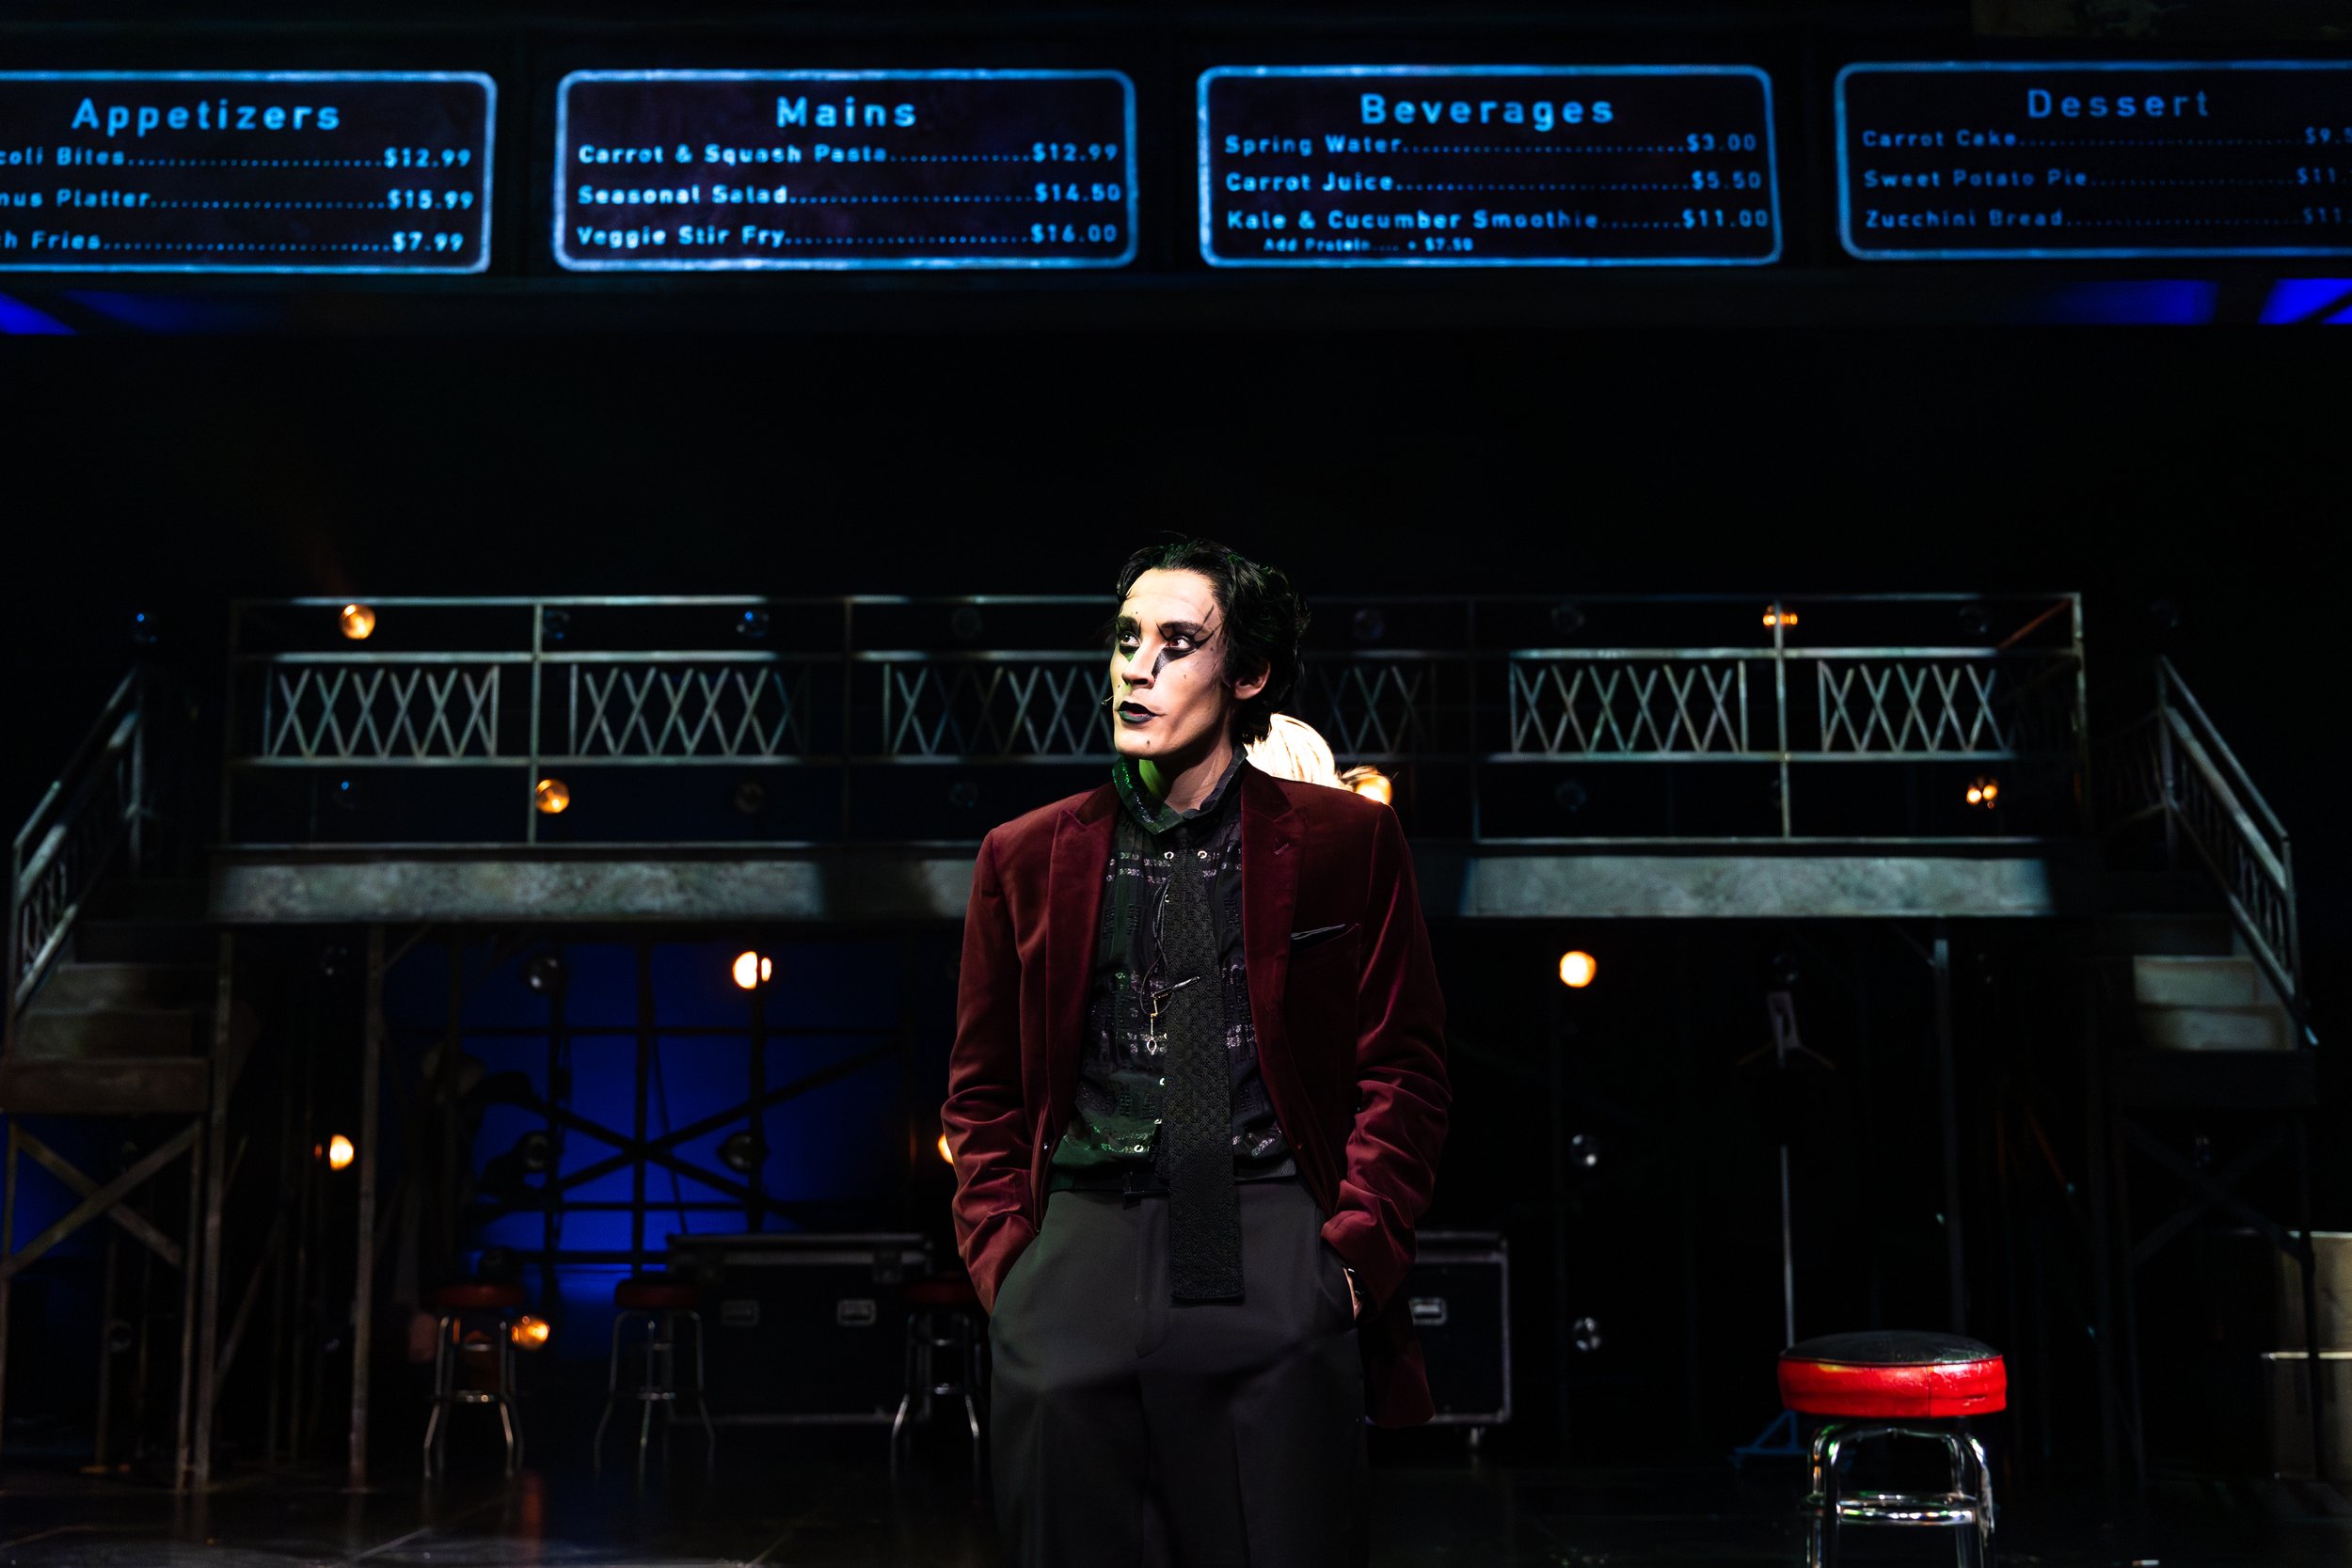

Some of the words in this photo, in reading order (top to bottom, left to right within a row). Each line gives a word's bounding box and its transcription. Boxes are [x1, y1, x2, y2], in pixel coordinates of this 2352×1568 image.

[776, 95, 916, 128] Mains
[1360, 92, 1613, 133] Beverages
[2027, 88, 2208, 119] Dessert
[71, 97, 340, 137] Appetizers
[1225, 135, 1312, 157] Spring
[1324, 135, 1402, 153] Water
[1686, 133, 1756, 153] $3.00
[1862, 130, 1944, 148] Carrot
[1956, 129, 2017, 147] Cake
[56, 146, 125, 166] Bites
[384, 147, 471, 169] $12.99
[578, 143, 664, 165] Carrot
[675, 143, 693, 164] &
[704, 143, 803, 167] Squash
[814, 143, 887, 164] Pasta
[1032, 142, 1118, 163] $12.99
[1225, 171, 1311, 192] Carrot
[1322, 171, 1393, 192] Juice
[1691, 170, 1761, 191] $5.50
[1864, 169, 1940, 188] Sweet
[1952, 168, 2035, 187] Potato
[2047, 168, 2087, 186] Pie
[2296, 166, 2352, 185] $11.
[56, 188, 151, 208] Platter
[387, 188, 474, 211] $15.99
[578, 183, 701, 205] Seasonal
[711, 183, 789, 205] Salad
[1034, 182, 1121, 203] $14.50
[1227, 210, 1287, 230] Kale
[1297, 210, 1316, 230] &
[1327, 209, 1461, 230] Cucumber
[1472, 209, 1597, 230] Smoothie
[1681, 208, 1770, 230] $11.00
[1866, 210, 1976, 229] Zucchini
[1988, 209, 2063, 227] Bread
[31, 230, 101, 250] Fries
[391, 230, 464, 253] $7.99
[576, 225, 667, 250] Veggie
[676, 224, 731, 245] Stir
[740, 224, 787, 248] Fry
[1030, 223, 1117, 244] $16.00
[1263, 237, 1298, 252] Add
